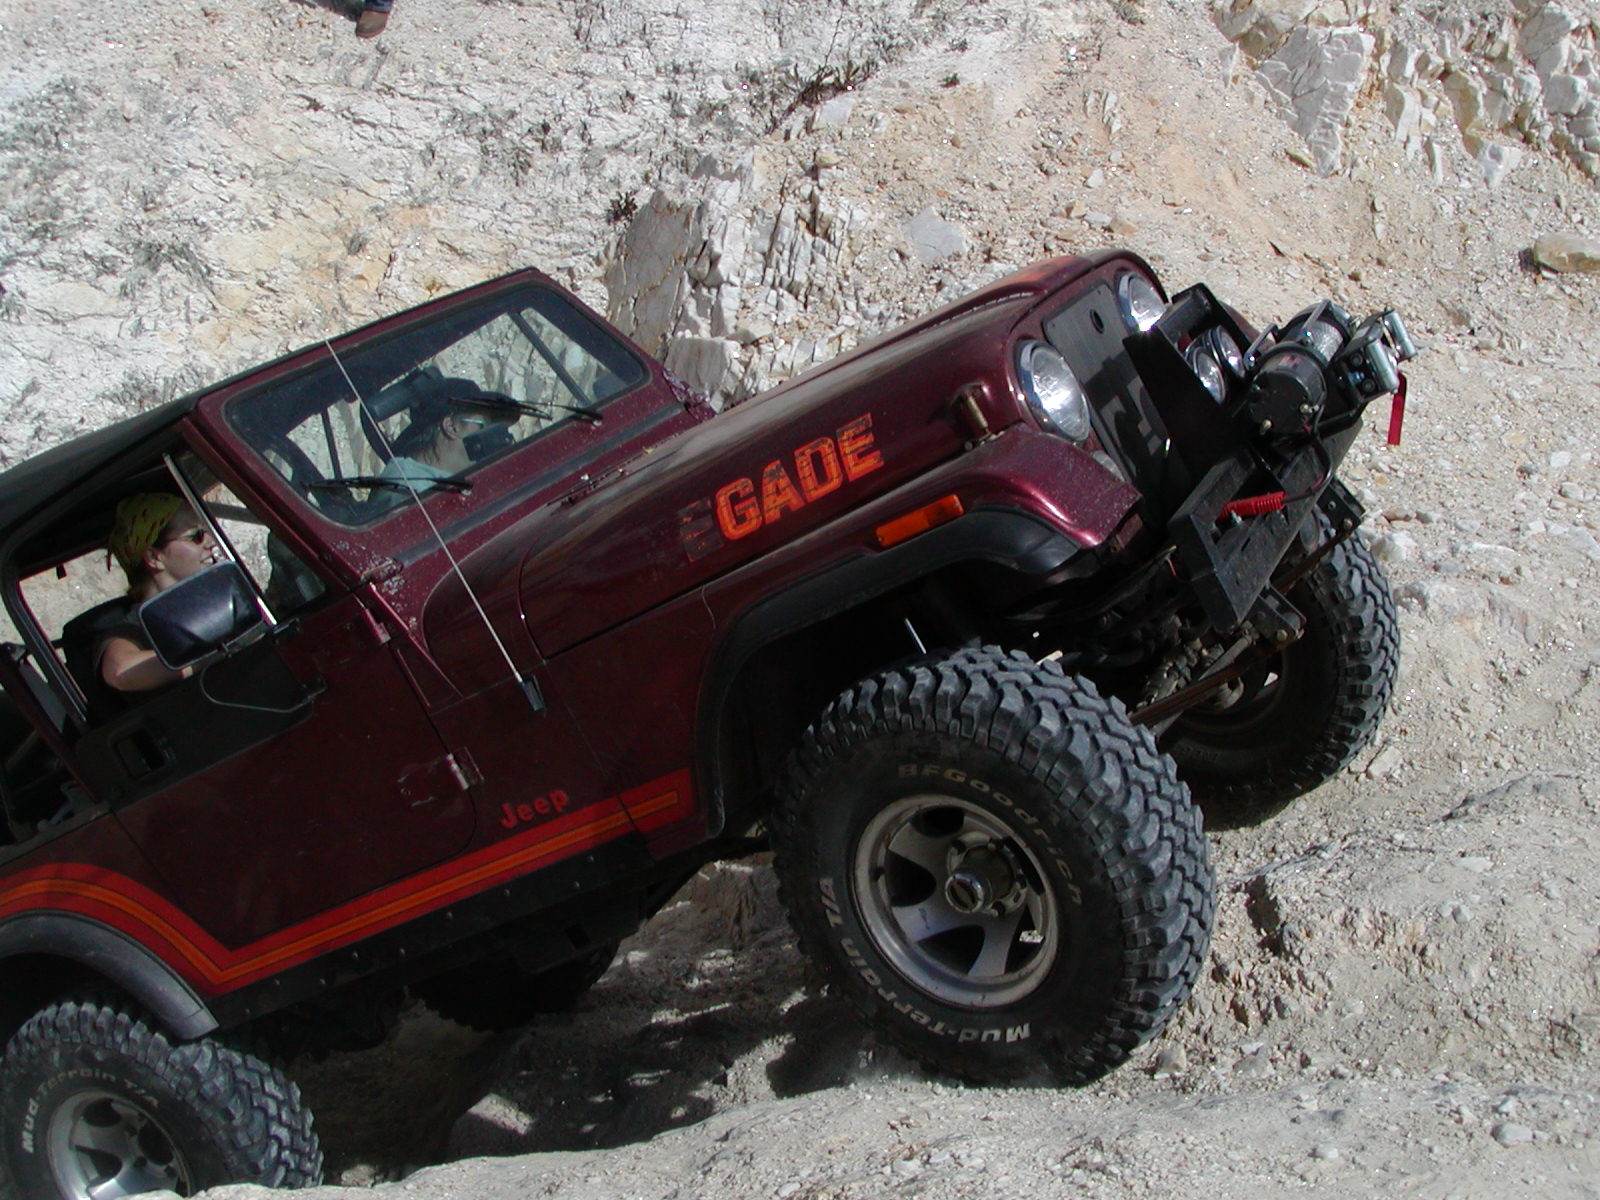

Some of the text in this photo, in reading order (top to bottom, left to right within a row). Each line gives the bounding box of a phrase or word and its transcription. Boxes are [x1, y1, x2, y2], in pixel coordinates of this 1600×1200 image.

[498, 788, 570, 830] Jeep
[897, 763, 1084, 905] BFGoodrich
[817, 876, 1031, 1045] Mud-Terrain T/A
